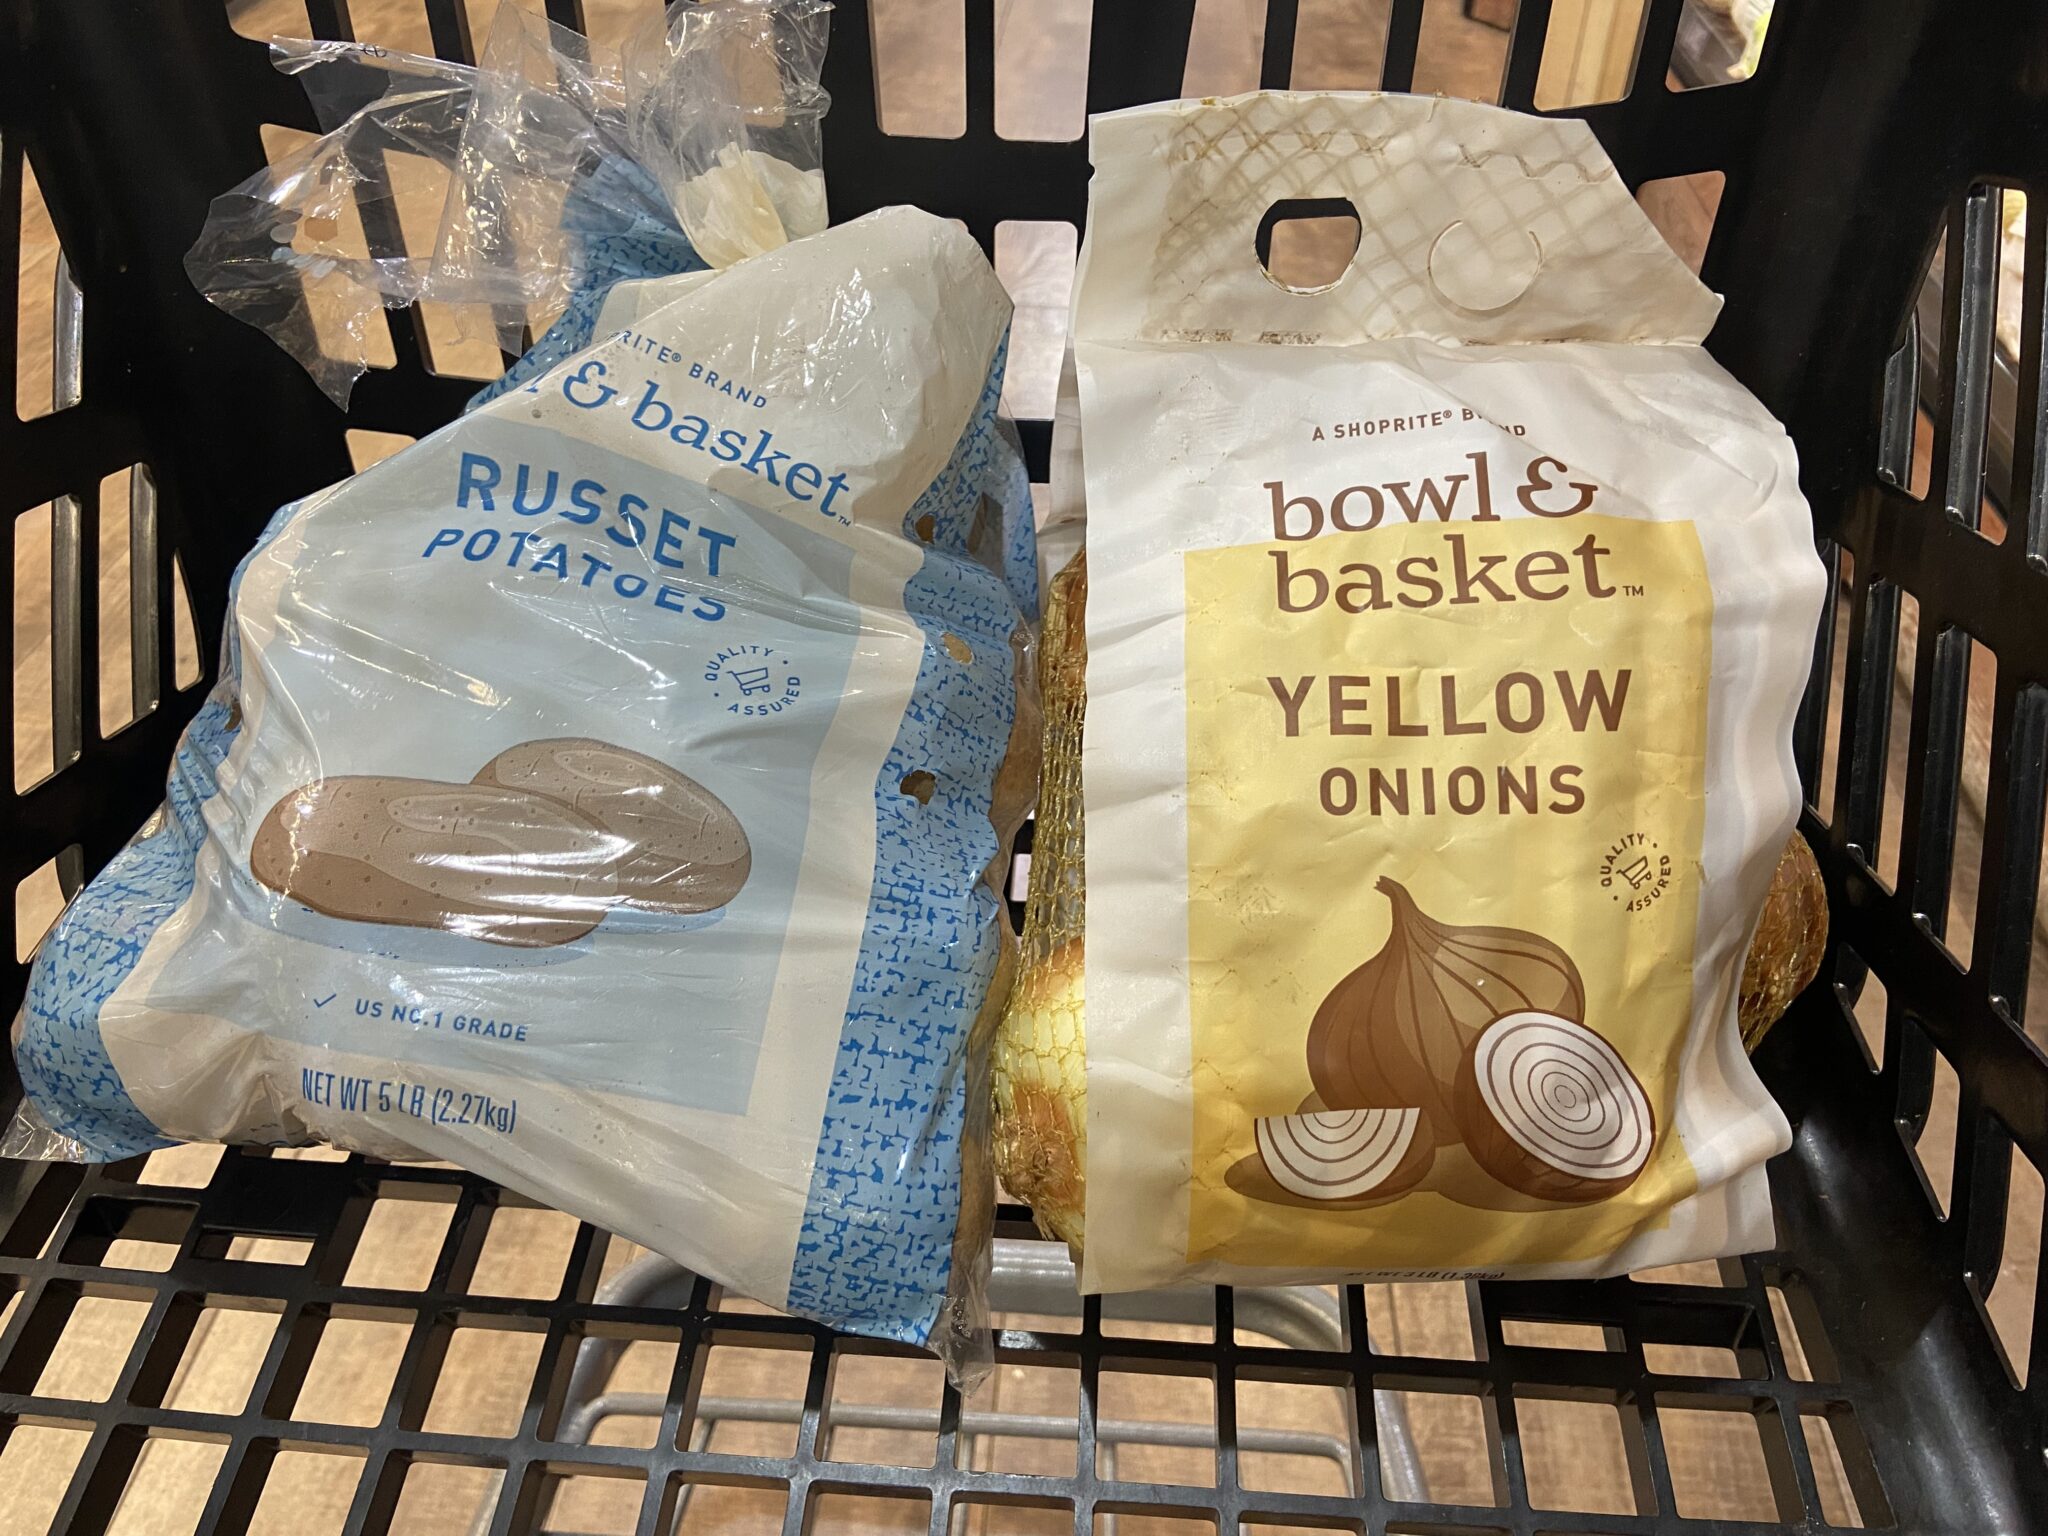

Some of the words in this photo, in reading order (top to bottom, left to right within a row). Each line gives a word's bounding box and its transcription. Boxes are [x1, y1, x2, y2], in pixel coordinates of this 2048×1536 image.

[563, 361, 618, 409] &
[688, 363, 767, 408] BRAND
[1311, 426, 1325, 441] A
[456, 452, 737, 578] RUSSET
[1263, 451, 1501, 541] bowl
[1516, 456, 1599, 518] &
[422, 528, 727, 622] POTATOES
[704, 645, 774, 681] QUALITY
[727, 676, 801, 716] ASSURED
[1266, 669, 1632, 738] YELLOW
[1319, 765, 1586, 816] ONIONS
[1600, 832, 1645, 887] QUALITY
[1625, 855, 1671, 912] ASSURED
[355, 998, 384, 1018] US
[453, 1015, 529, 1042] GRADE
[302, 1067, 335, 1107] NET
[340, 1075, 372, 1112] WT
[379, 1081, 392, 1113] 5
[399, 1083, 426, 1118] LB
[431, 1087, 517, 1134] (2.27kg)
